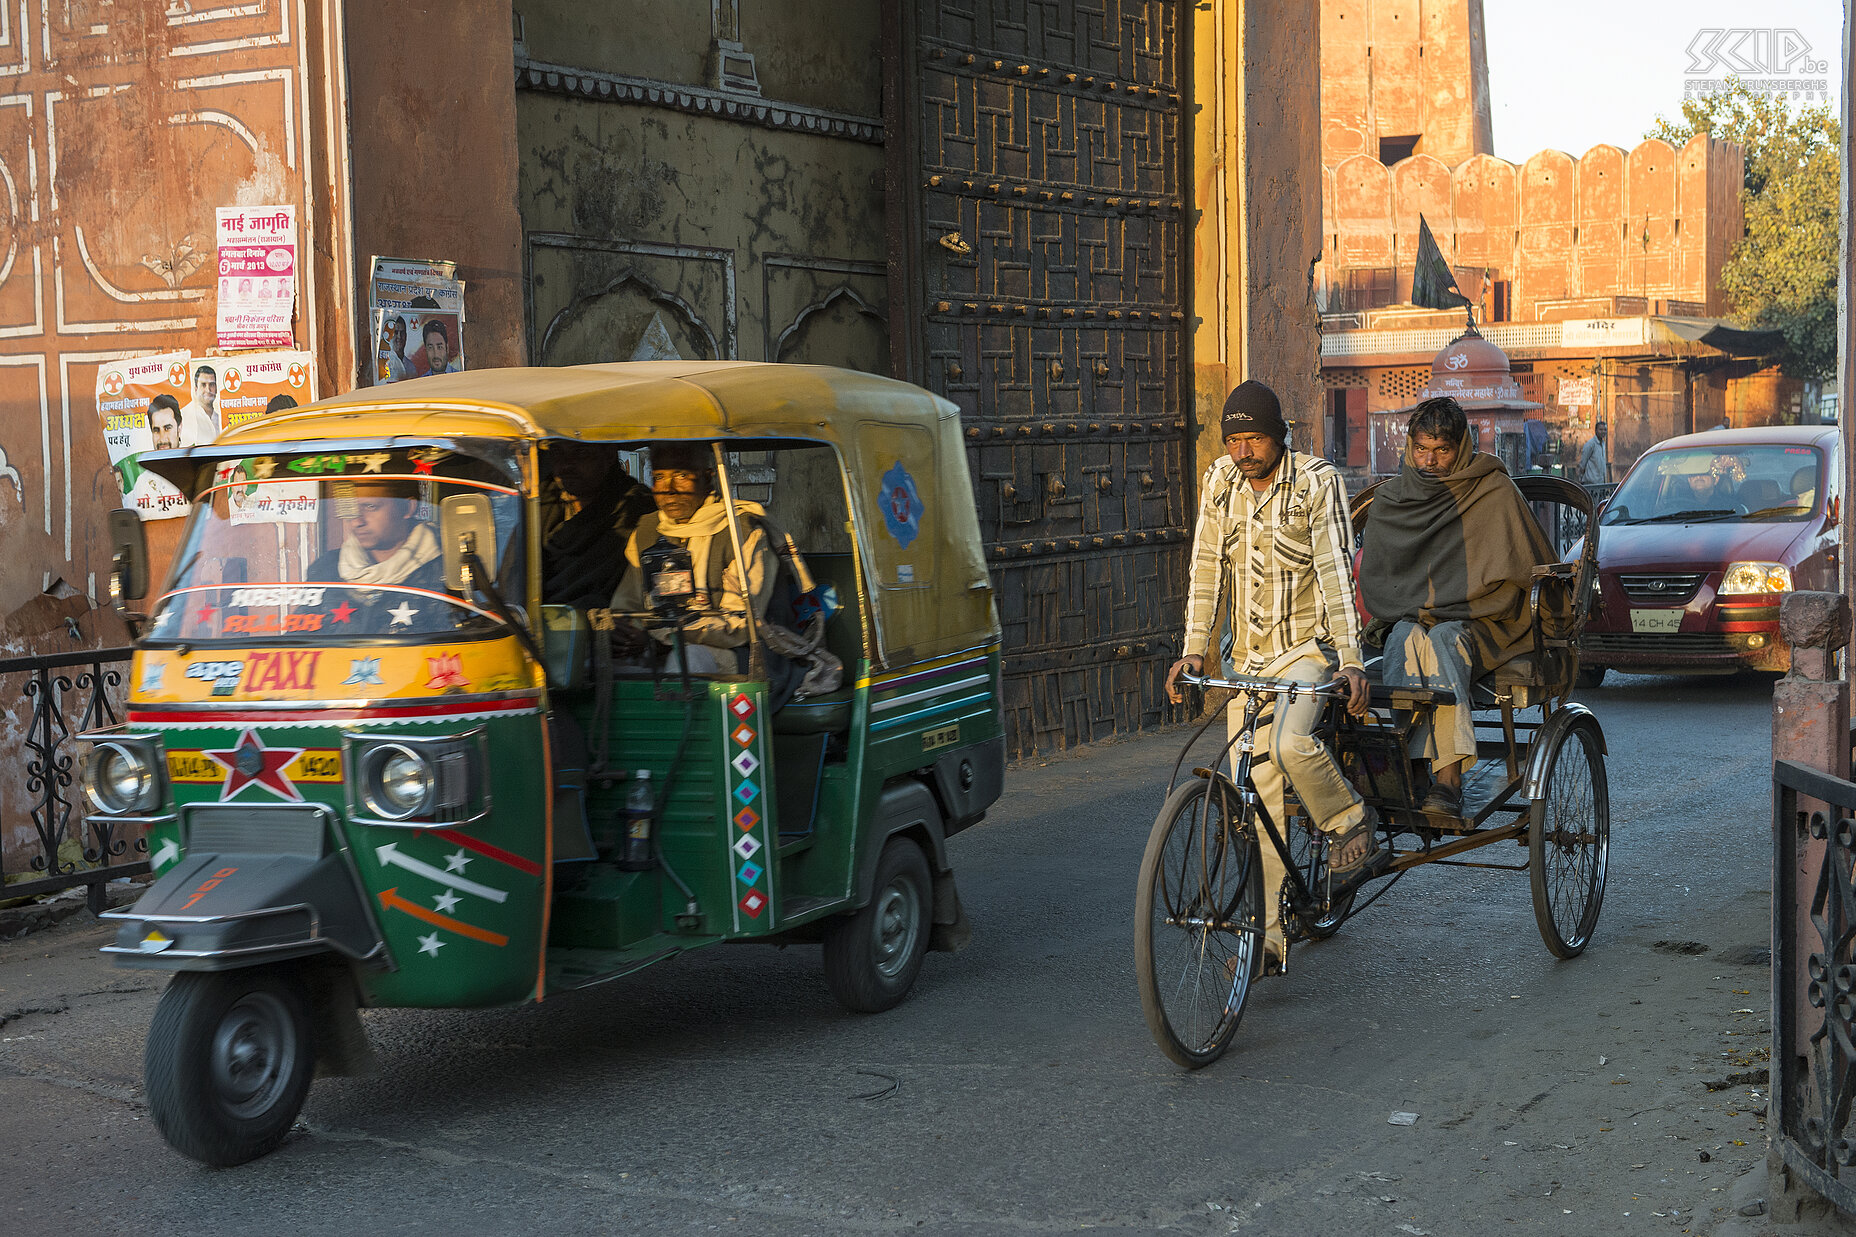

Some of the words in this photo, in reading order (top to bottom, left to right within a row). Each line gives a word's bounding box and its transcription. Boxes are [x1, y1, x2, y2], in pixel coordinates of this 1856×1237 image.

[221, 213, 245, 233] नाई
[249, 212, 290, 235] जागृति
[221, 248, 246, 258] मंगलवार
[246, 247, 266, 258] दिनांक
[231, 260, 246, 270] मार्च
[247, 261, 265, 271] 2013
[377, 281, 407, 294] राजस्थान
[408, 284, 424, 296] प्रदेश
[439, 286, 458, 299] कांग्रेस
[141, 361, 163, 374] कांग्रेस
[260, 361, 282, 373] कांग्रेस
[124, 398, 139, 409] विधान
[139, 397, 151, 408] सभा
[242, 396, 257, 407] विधान
[106, 412, 147, 431] अध्यक्ष
[108, 435, 119, 446] पद
[136, 493, 155, 509] मो.
[258, 496, 274, 512] मो.
[278, 494, 317, 516] नूरुद्दीन
[221, 613, 327, 633] ALLAH
[1633, 619, 1646, 628] 14
[1649, 619, 1664, 628] CH
[1667, 619, 1680, 629] 45
[185, 660, 244, 682] ape
[244, 651, 323, 692] TAXI
[300, 756, 340, 777] 1420
